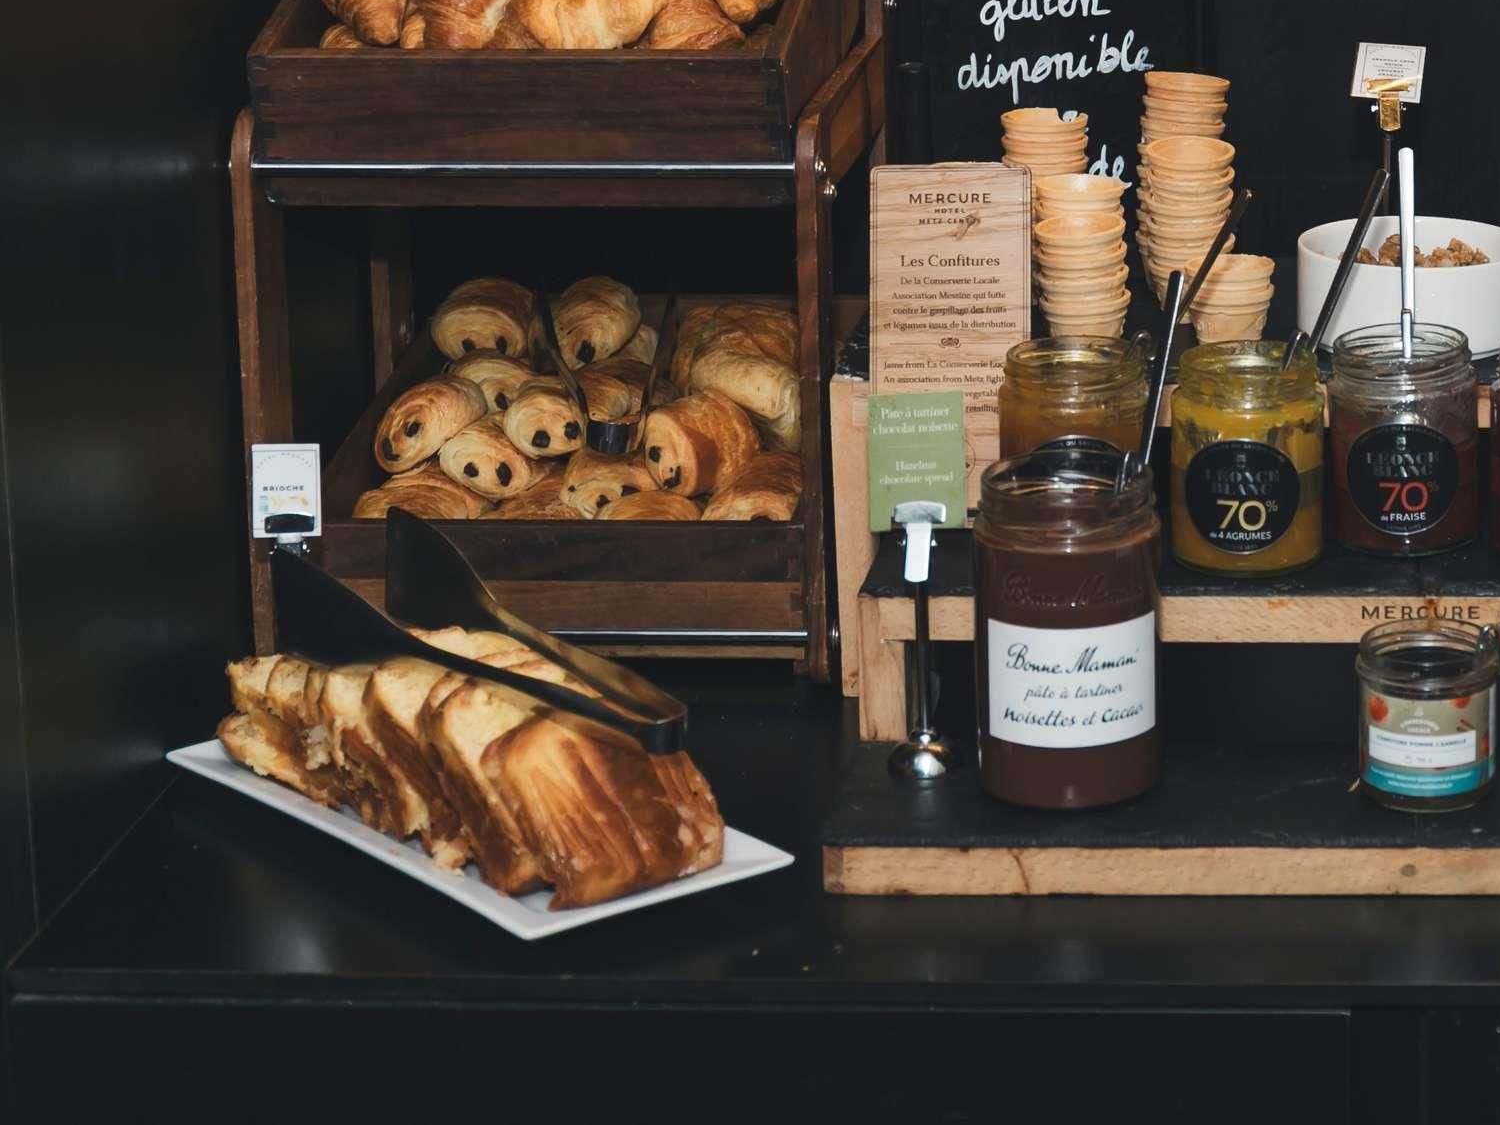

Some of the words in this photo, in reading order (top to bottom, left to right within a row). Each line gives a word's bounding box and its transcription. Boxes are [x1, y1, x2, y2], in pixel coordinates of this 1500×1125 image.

[957, 29, 1155, 105] disponible
[909, 193, 992, 204] MERCURE
[900, 255, 924, 267] Les
[928, 255, 1000, 267] Confitures
[900, 277, 912, 285] De
[914, 277, 921, 285] la
[924, 277, 972, 285] Conserverie
[974, 277, 1000, 285] Locale
[892, 292, 937, 300] Association
[939, 292, 970, 300] Messine
[973, 292, 986, 301] qui
[988, 292, 1006, 300] lutte
[893, 307, 919, 315] contre
[920, 307, 928, 315] le
[971, 307, 984, 315] des
[986, 307, 1007, 315] fruits
[894, 321, 927, 331] légumes
[950, 321, 959, 329] de
[961, 321, 969, 329] la
[971, 321, 1016, 329] distribution
[1378, 481, 1440, 512] 70%
[1216, 499, 1278, 531] 70%
[1390, 512, 1426, 522] FRAISE
[1218, 531, 1224, 539] 4
[1225, 531, 1272, 539] AGRUMES
[1361, 605, 1481, 620] MERCURE
[1006, 643, 1060, 675] Bonne
[1065, 644, 1136, 675] Maman
[1024, 685, 1055, 702] pâte
[1060, 685, 1068, 699] à
[1074, 683, 1124, 700] tartiner
[1003, 705, 1076, 727] noisettes
[1082, 709, 1098, 726] et
